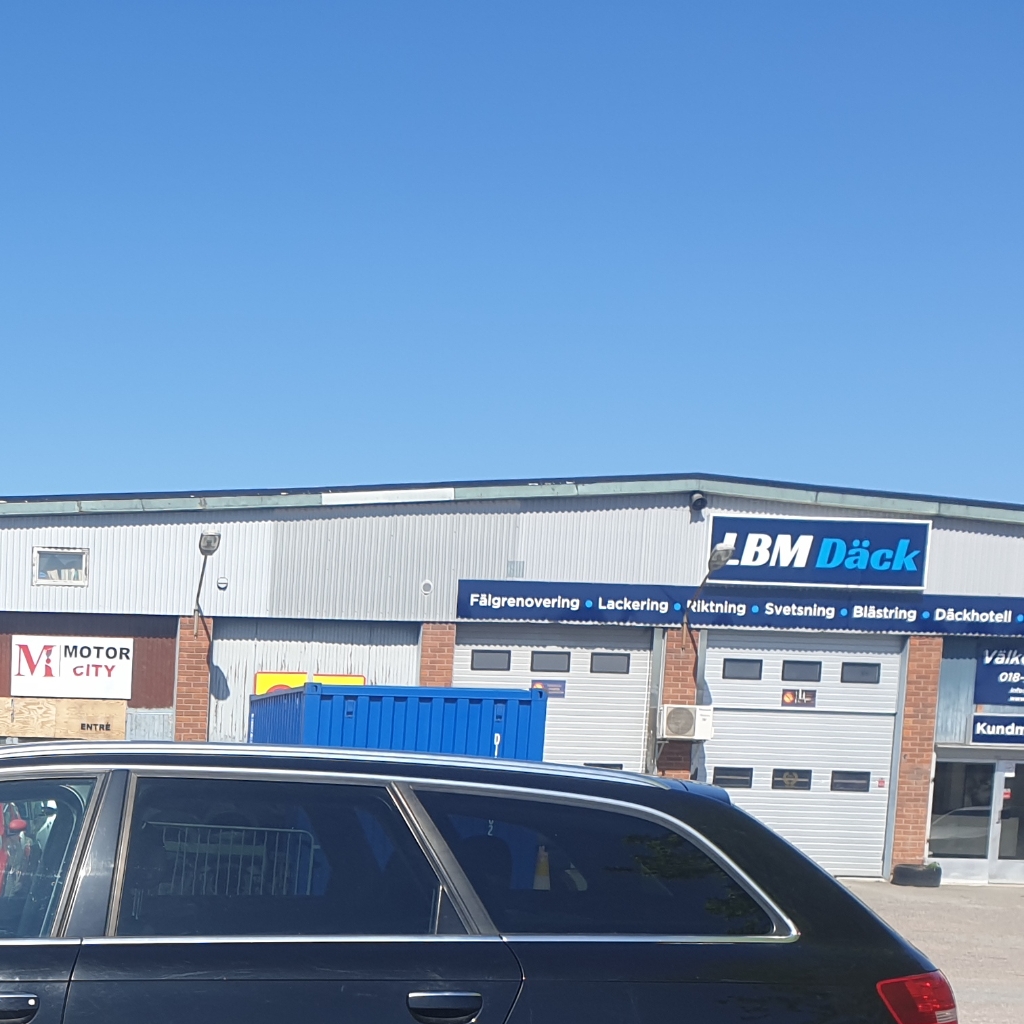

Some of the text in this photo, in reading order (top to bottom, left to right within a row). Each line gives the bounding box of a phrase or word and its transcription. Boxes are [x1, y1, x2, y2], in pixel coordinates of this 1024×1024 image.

[816, 537, 921, 571] Däck
[470, 593, 1012, 623] Fälgrenovering Lackering Riktning Svetsning Blästring Däckhotell
[64, 645, 131, 660] MOTOR
[72, 664, 116, 678] CITY
[998, 671, 1024, 682] 018-
[80, 723, 111, 731] ENTRÉ
